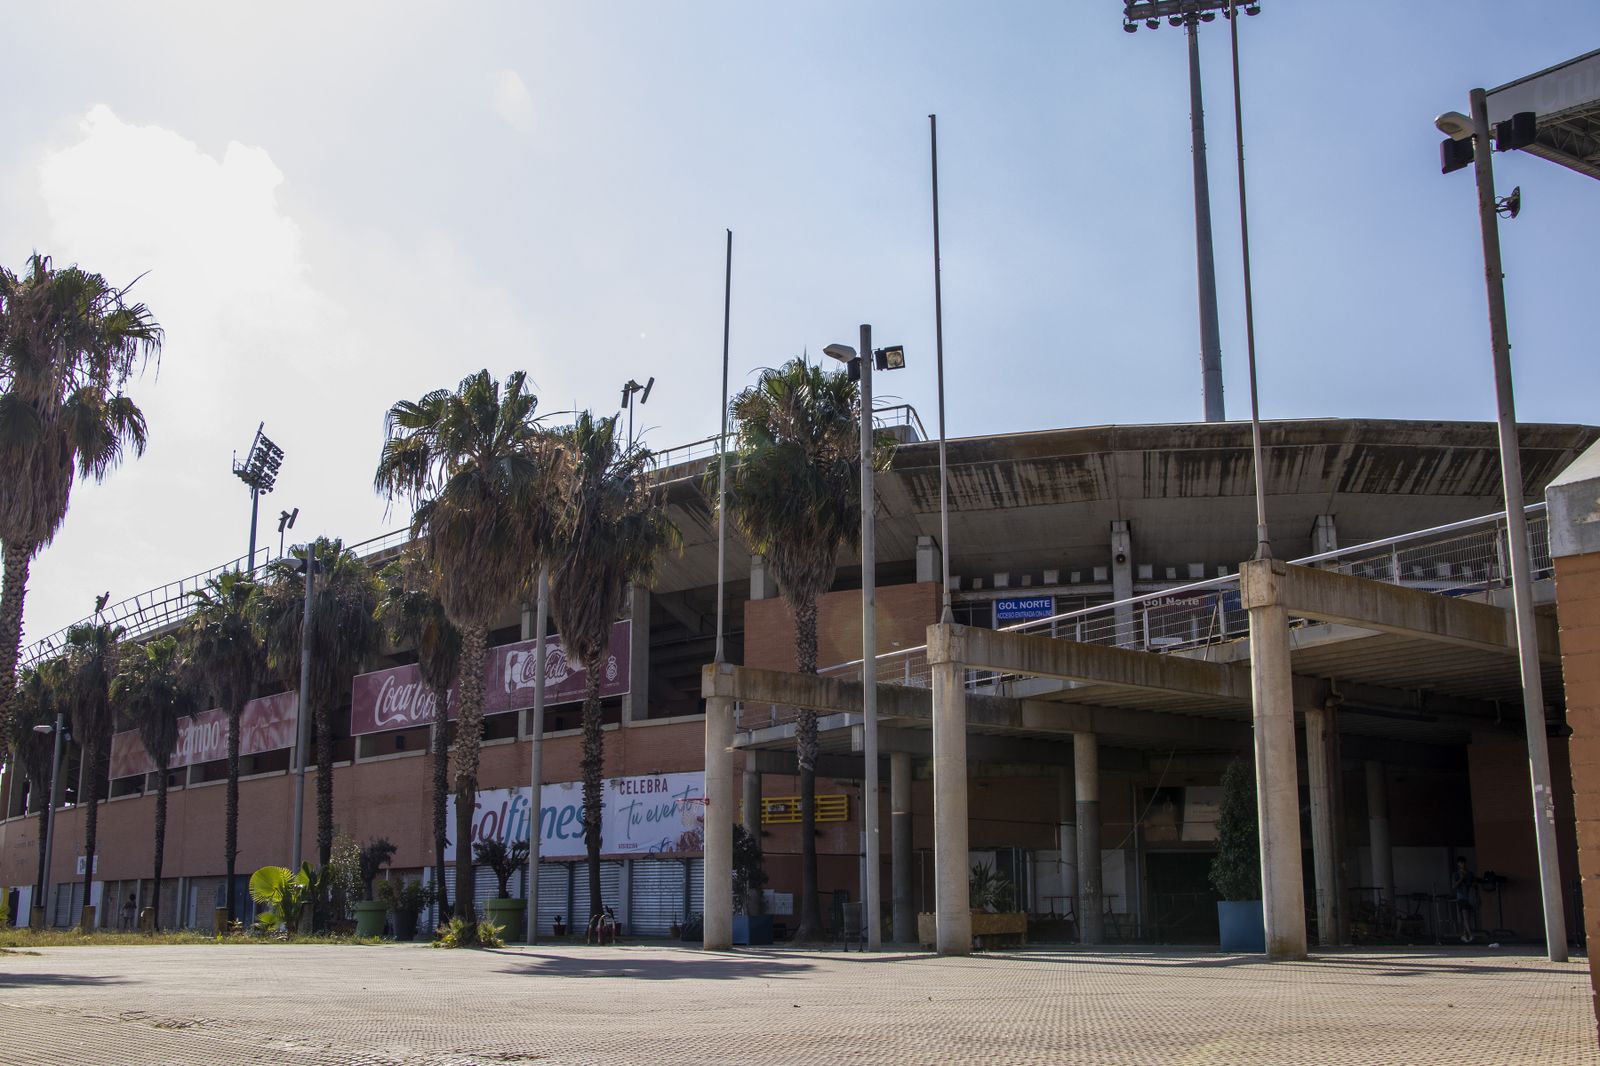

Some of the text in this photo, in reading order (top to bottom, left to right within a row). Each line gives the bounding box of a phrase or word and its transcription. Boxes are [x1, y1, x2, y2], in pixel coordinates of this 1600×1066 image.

[998, 600, 1051, 610] GOL NORTE
[1143, 597, 1199, 606] Gol Norte
[620, 778, 668, 795] CELEBRA
